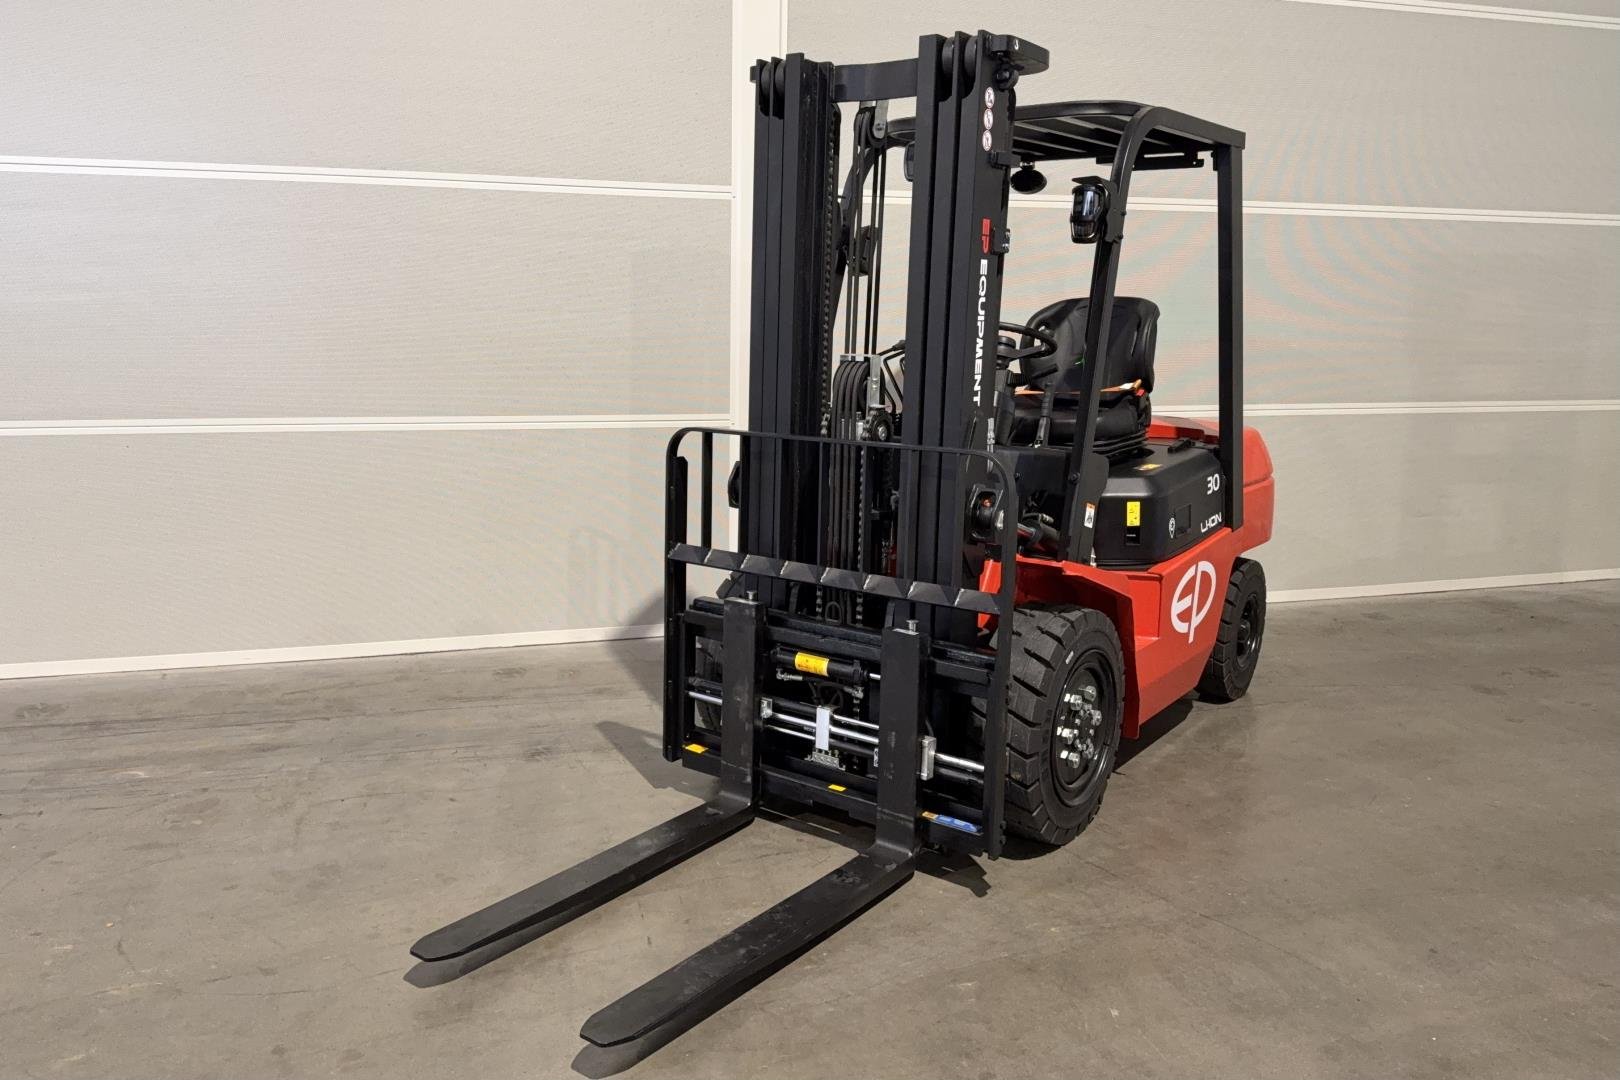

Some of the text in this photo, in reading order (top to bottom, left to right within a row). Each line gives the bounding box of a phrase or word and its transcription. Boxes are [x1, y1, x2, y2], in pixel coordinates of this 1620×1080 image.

[973, 218, 990, 406] EP EQUIPMENT
[1207, 473, 1220, 495] 30
